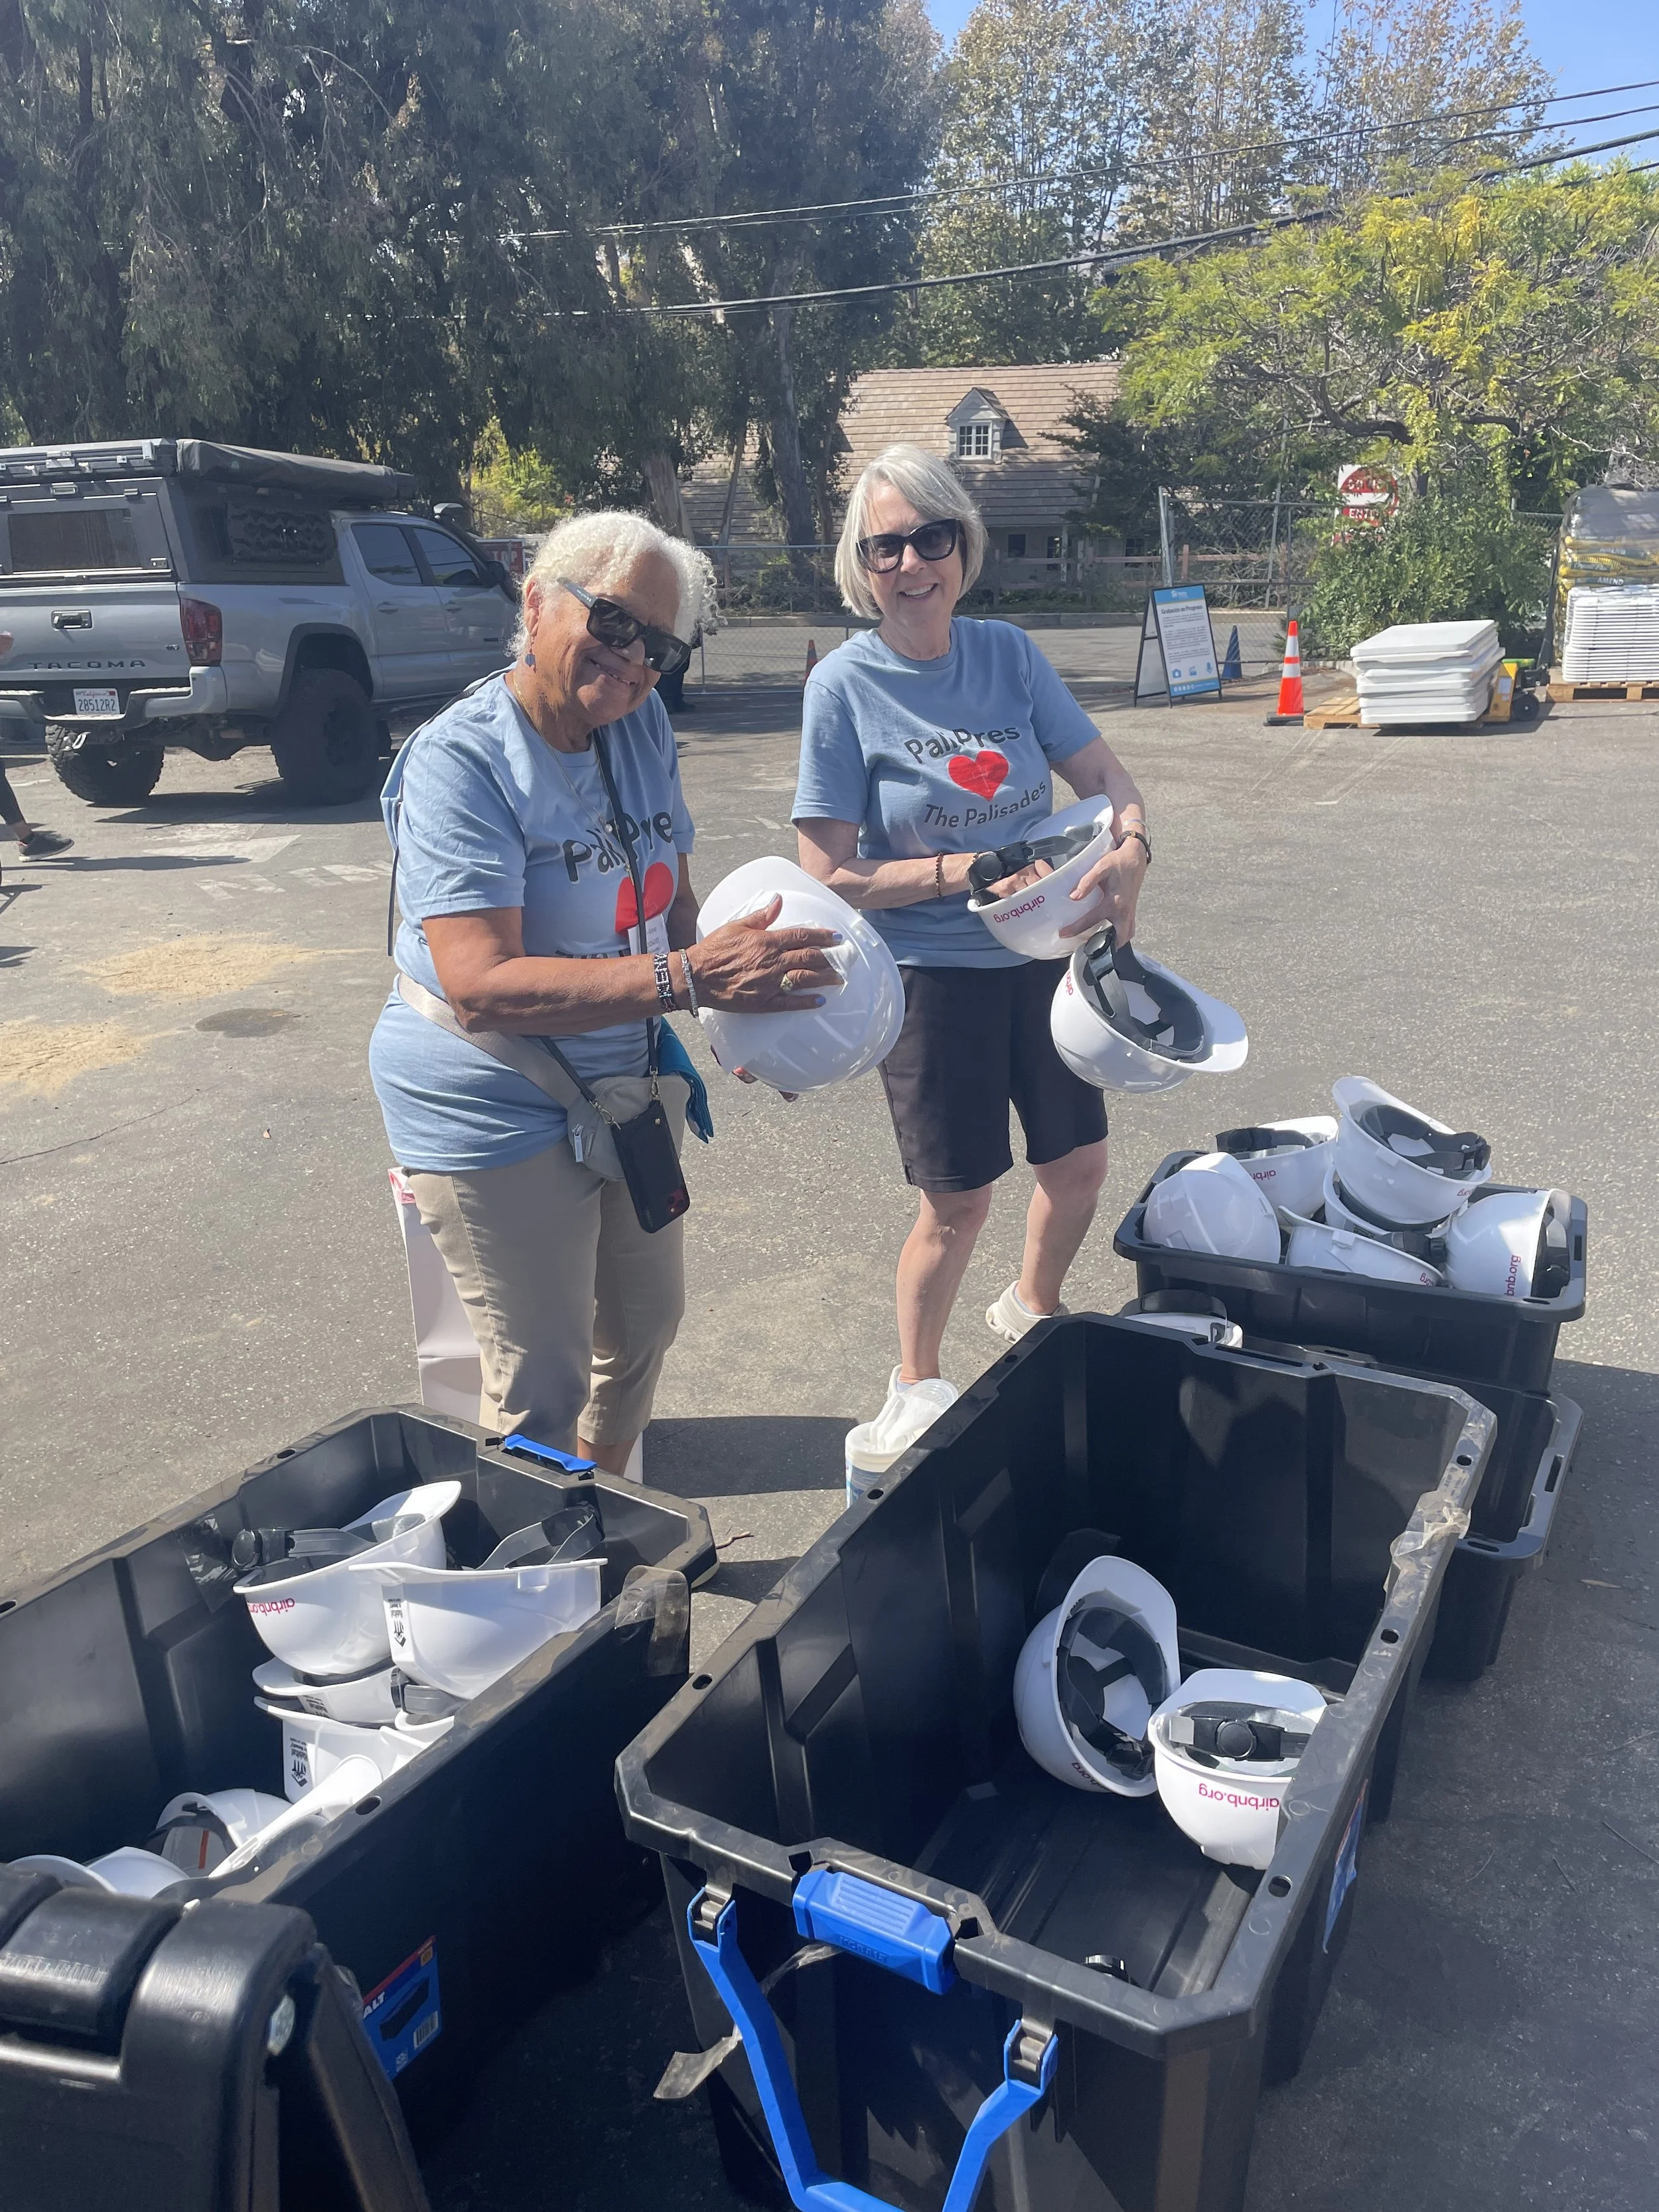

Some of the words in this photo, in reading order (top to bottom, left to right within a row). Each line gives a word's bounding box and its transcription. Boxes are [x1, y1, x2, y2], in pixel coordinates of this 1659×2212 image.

[28, 660, 145, 670] TACOMA
[78, 699, 116, 711] 28512R2
[924, 804, 959, 828] The
[965, 781, 1046, 827] Palisades
[993, 895, 1045, 922] airbnb.org
[1504, 1254, 1522, 1296] bnb.org
[1199, 1783, 1279, 1811] airbnb.org
[363, 1992, 386, 2019] ALT
